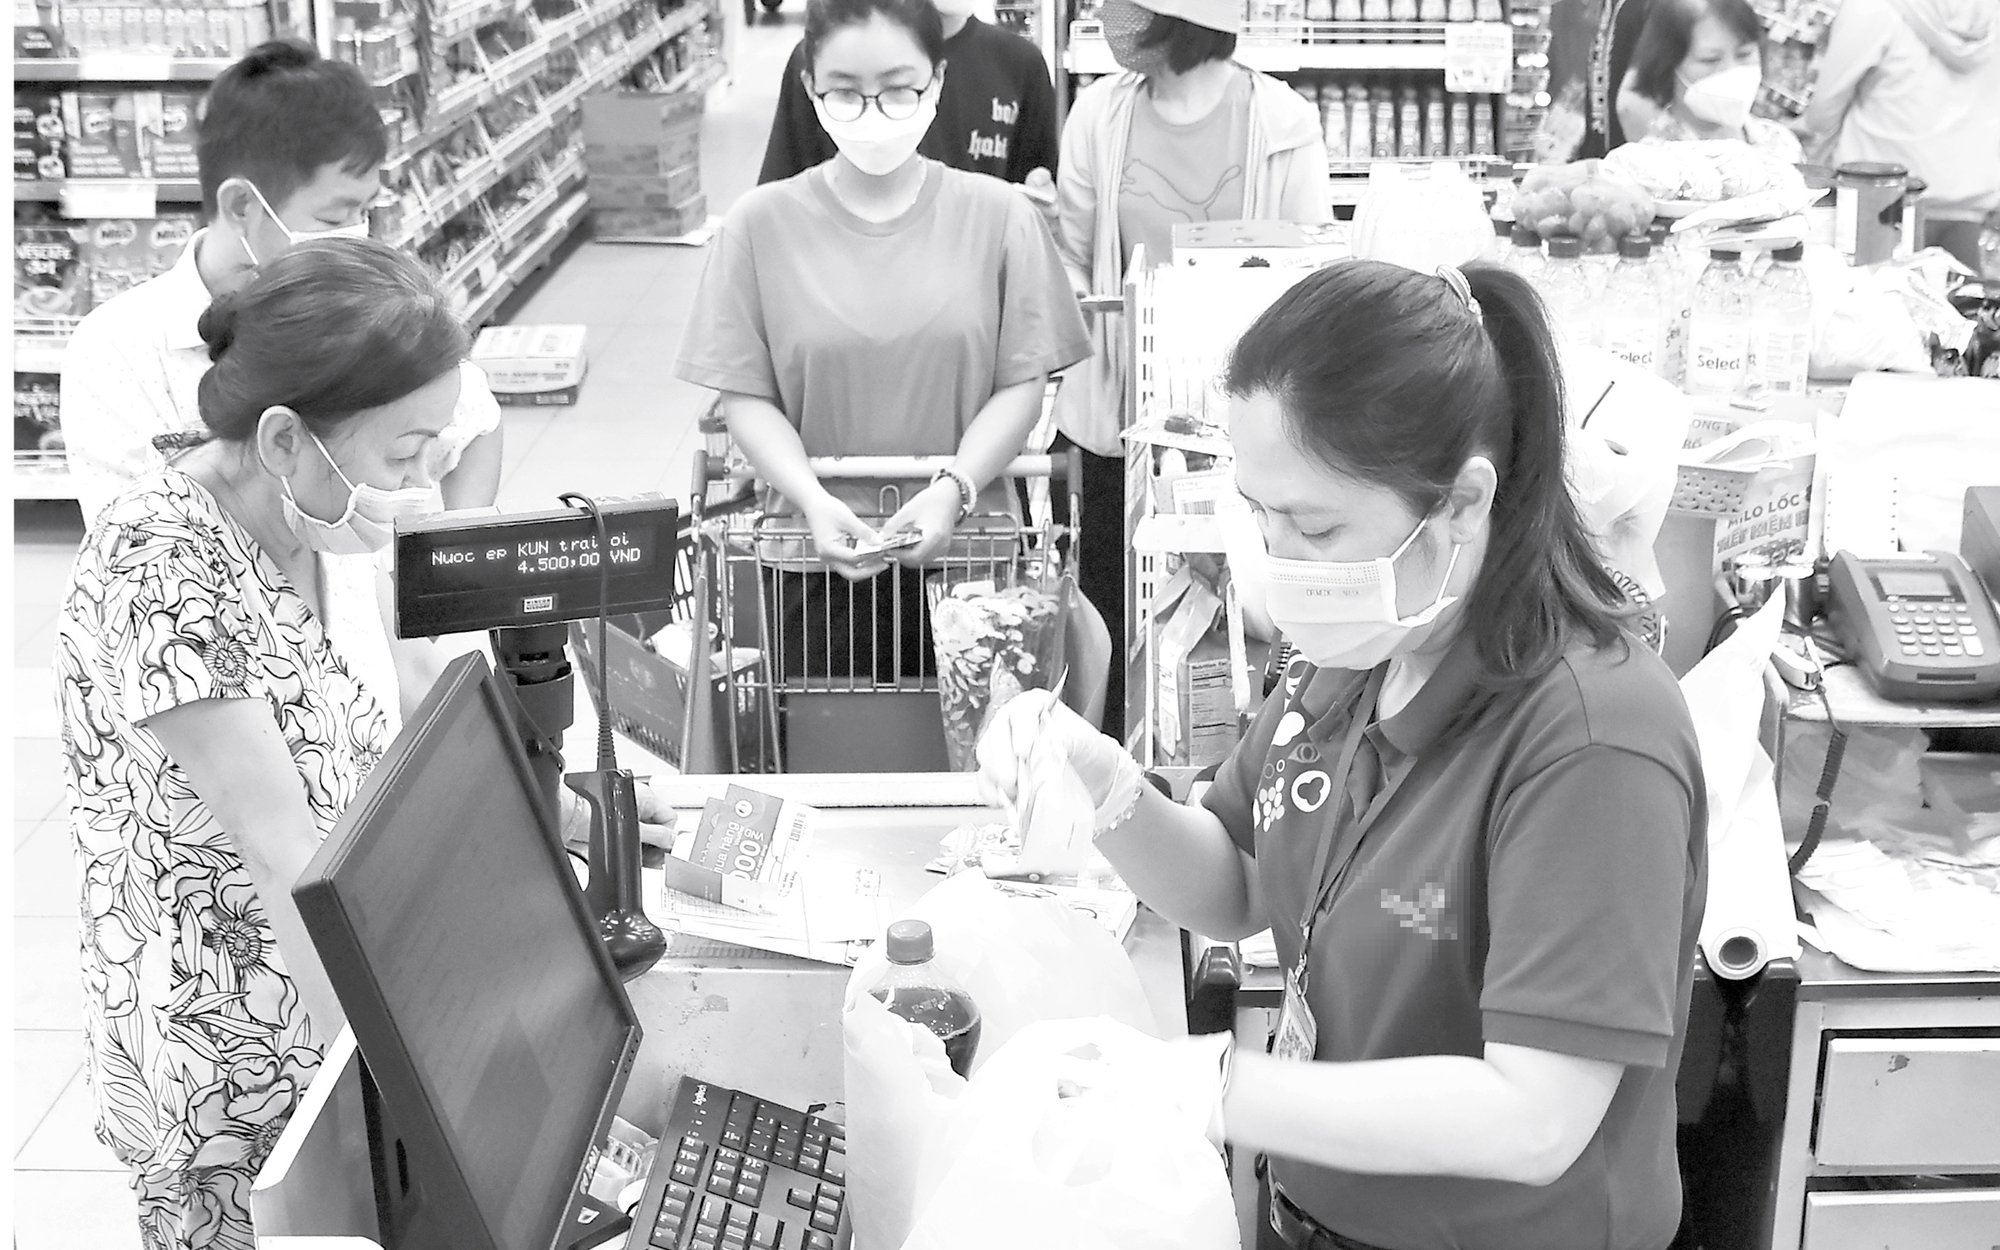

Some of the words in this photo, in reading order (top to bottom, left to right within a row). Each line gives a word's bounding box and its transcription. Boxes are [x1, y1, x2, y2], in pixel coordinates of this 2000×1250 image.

[1768, 492, 1800, 513] LỐC
[431, 550, 475, 566] Nuoc
[518, 539, 549, 557] KUN
[517, 552, 600, 575] 4.500,00
[609, 547, 641, 564] VND
